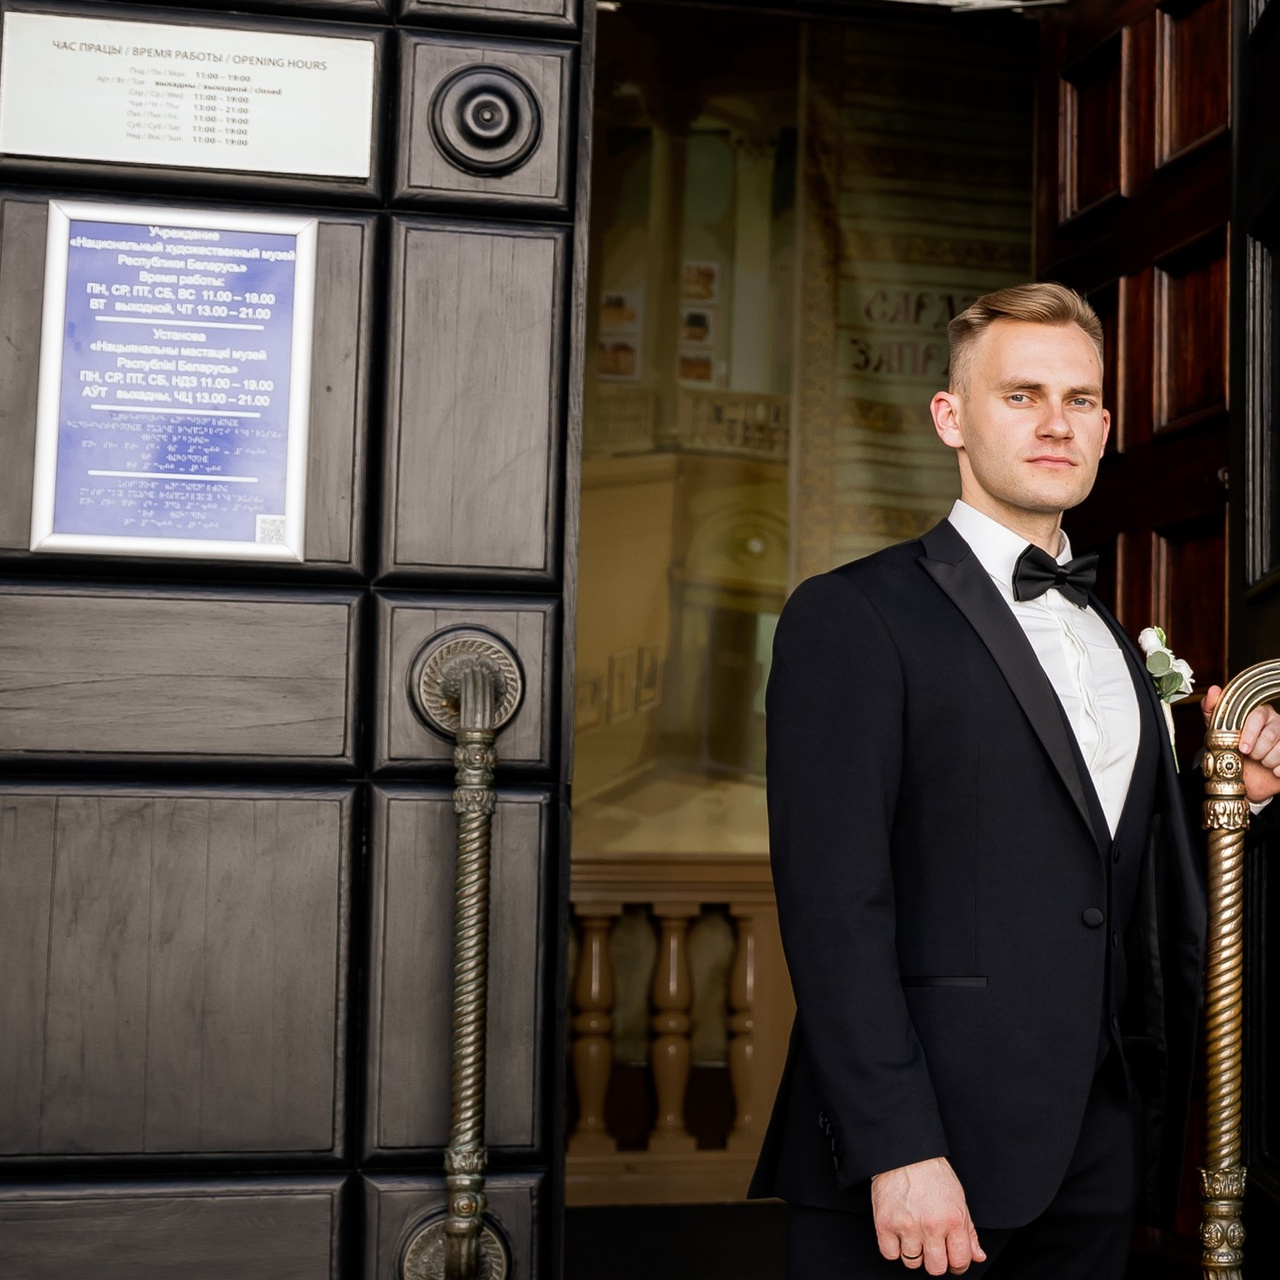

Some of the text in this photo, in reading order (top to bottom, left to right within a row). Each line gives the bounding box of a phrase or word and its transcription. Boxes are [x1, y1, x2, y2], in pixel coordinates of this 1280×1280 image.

[52, 40, 77, 52] ЧАС
[80, 42, 122, 56] ПРАЦЫ
[132, 47, 172, 59] ВРЕМЯ
[175, 50, 223, 63] РАБОТЫ
[232, 55, 285, 68] OPENING
[287, 60, 328, 71] HOURS
[149, 226, 220, 241] Учреждение
[70, 237, 296, 262] «Национальный художественный музей
[118, 254, 248, 274] Республики Беларусь»
[139, 270, 225, 287] Время работы:
[87, 282, 109, 296] ПН,
[154, 287, 175, 300] СБ,
[178, 288, 196, 300] ВС
[201, 290, 232, 302] 11.00
[244, 292, 276, 305] 19.00
[90, 298, 107, 310] ВТ
[115, 302, 175, 315] выходной,
[177, 304, 195, 315] ЧТ
[196, 305, 228, 317] 13.00
[239, 307, 271, 320] 21.00
[152, 328, 206, 342] Установа
[89, 340, 267, 362] «Нацыянальны мастацкі музей
[117, 357, 239, 375] Рэспублікі Беларусь»
[80, 370, 102, 383] ПН,
[148, 374, 170, 387] СБ,
[171, 375, 198, 389] НДЗ
[200, 377, 231, 389] 11.00
[242, 379, 274, 391] 19.00
[81, 385, 109, 398] АЎТ
[116, 389, 172, 402] выхадны,
[173, 391, 194, 404] ЧЦ
[194, 392, 227, 404] 13.00
[237, 394, 270, 407] 21.00
